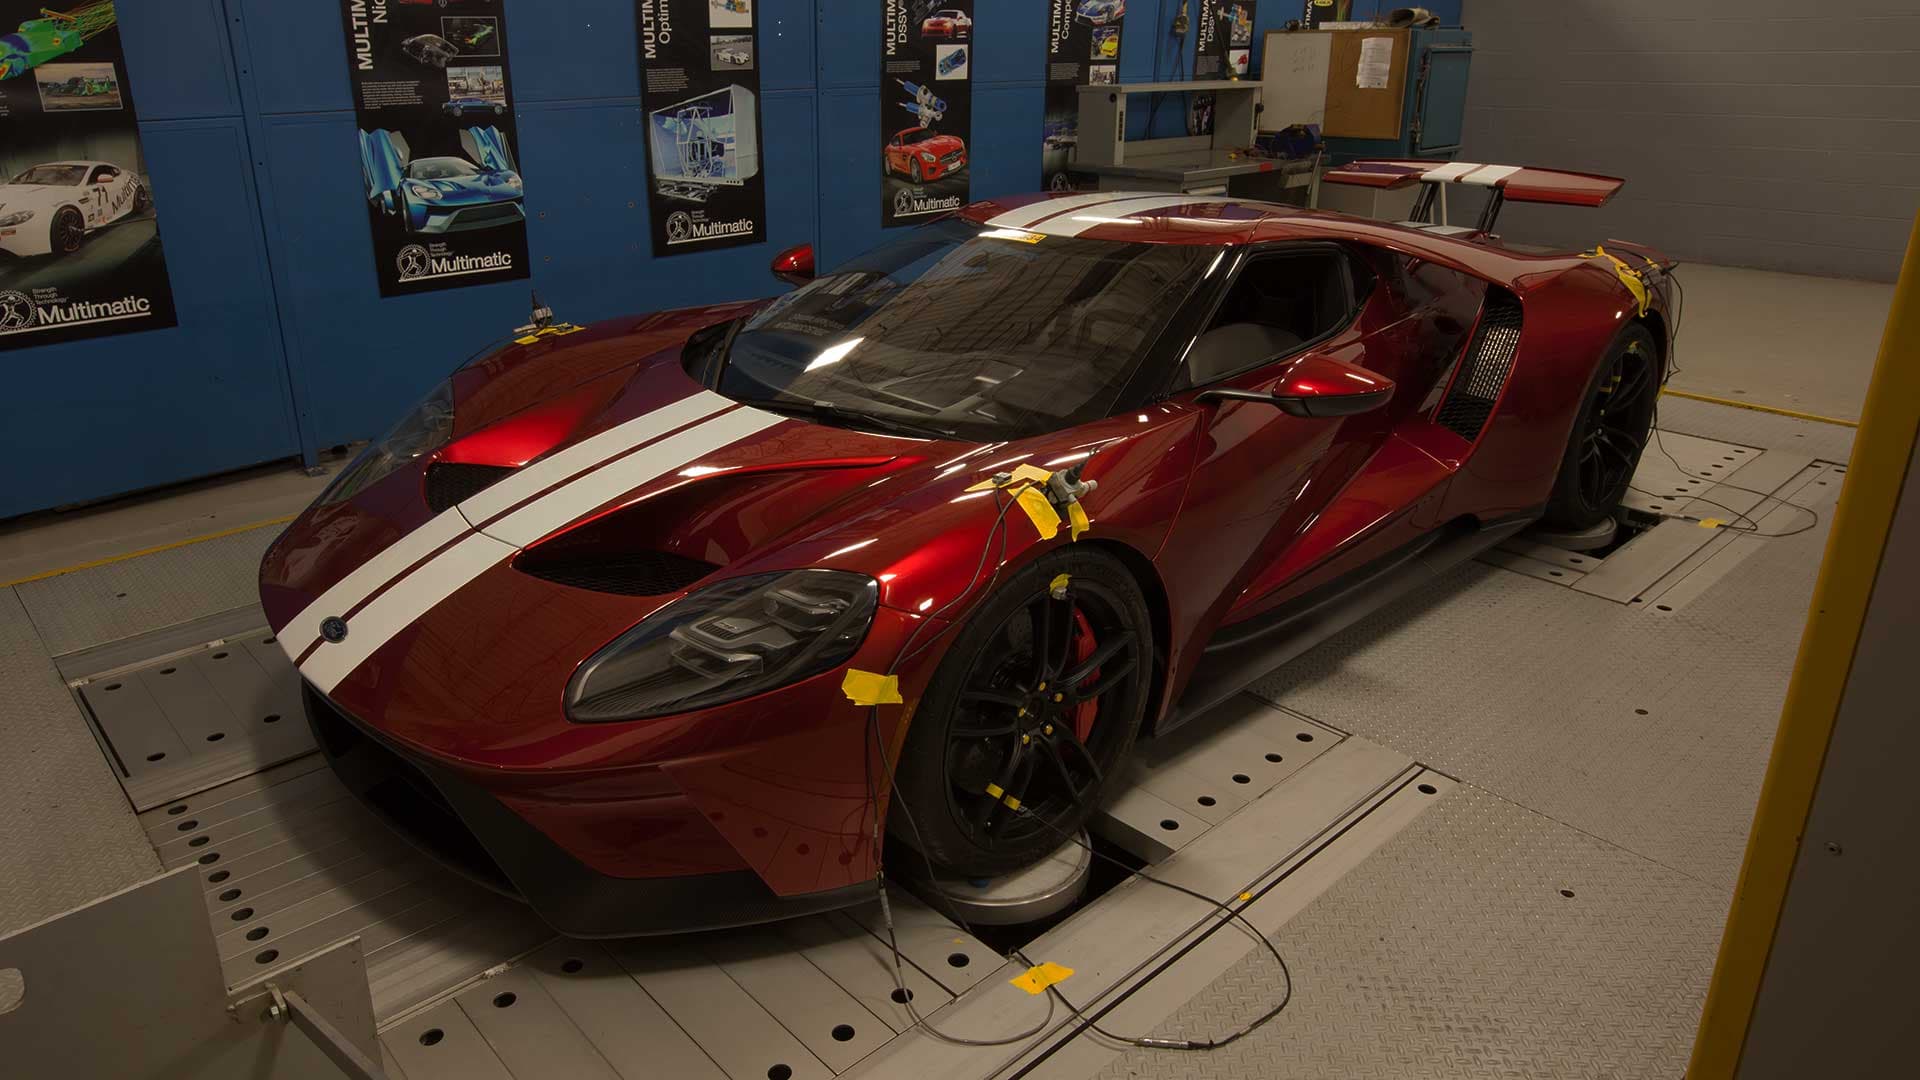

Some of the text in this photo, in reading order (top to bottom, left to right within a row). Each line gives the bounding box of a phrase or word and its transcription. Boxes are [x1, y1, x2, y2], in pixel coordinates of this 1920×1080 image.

[914, 195, 960, 211] Multimatic
[692, 218, 753, 237] Multimatic
[431, 252, 512, 274] Multimatic
[38, 296, 150, 325] Multimatic
